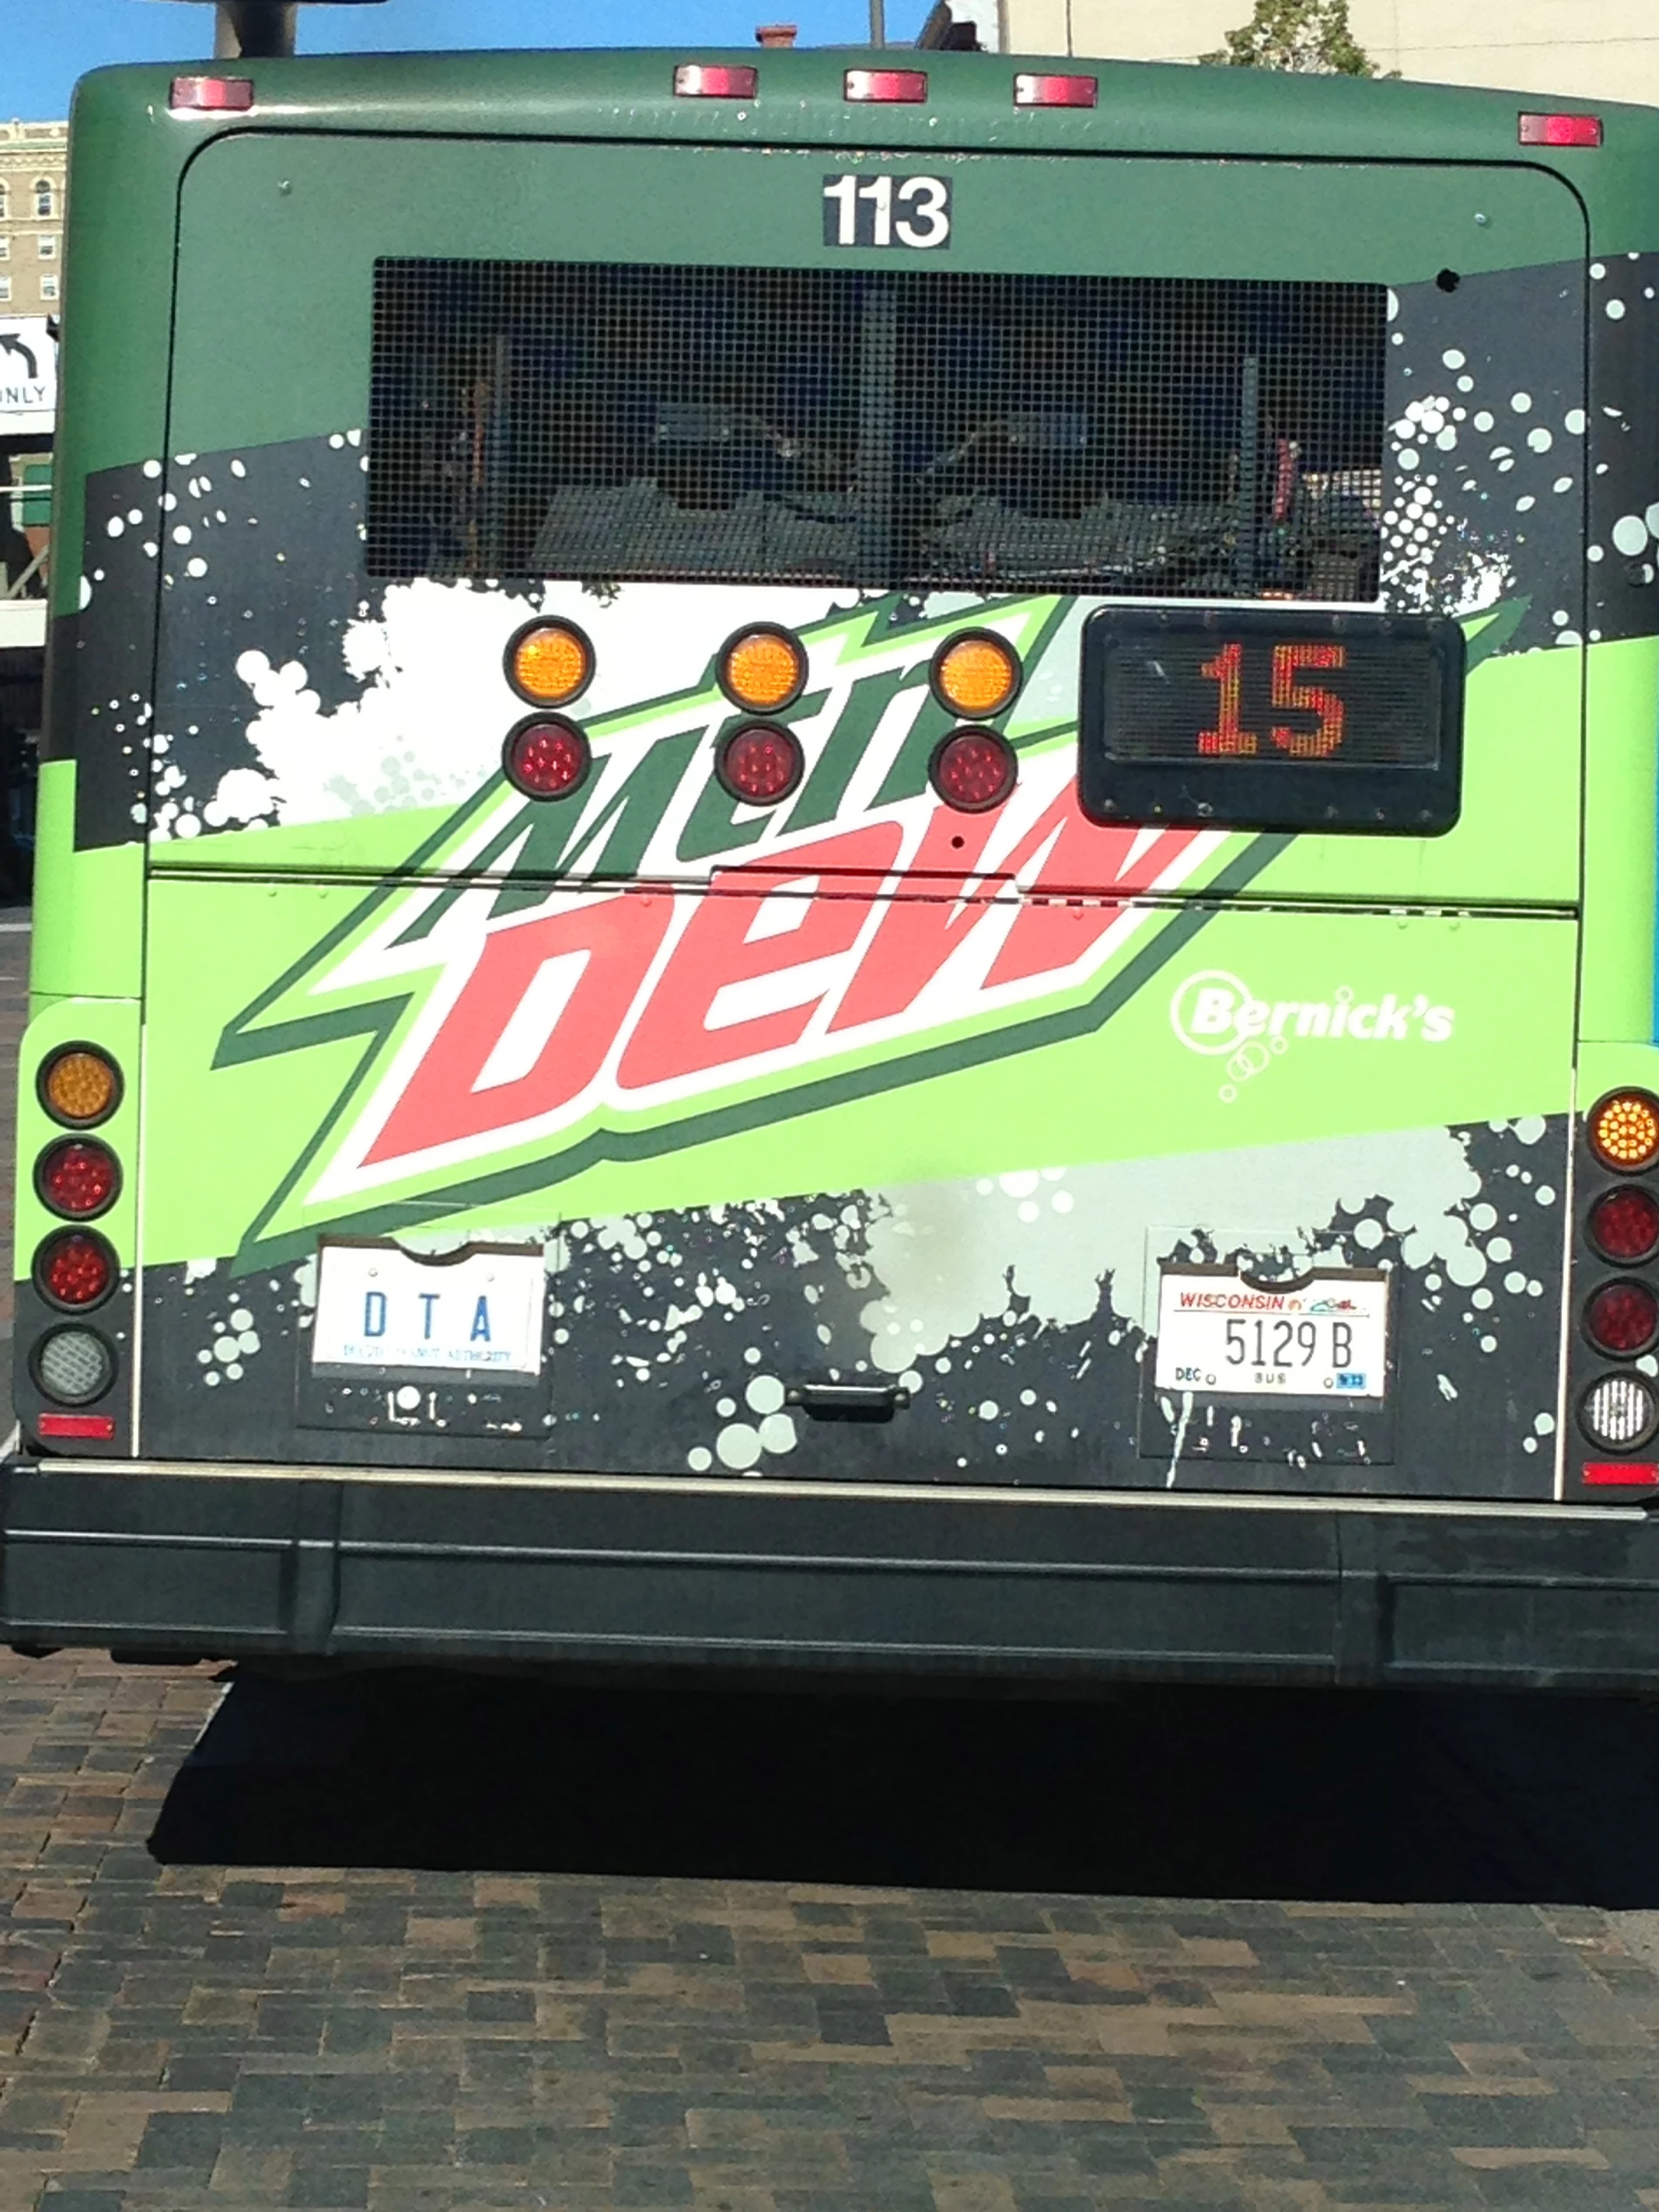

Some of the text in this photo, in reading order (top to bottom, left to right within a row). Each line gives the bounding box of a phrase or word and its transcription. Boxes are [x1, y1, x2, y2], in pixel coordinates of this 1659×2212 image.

[823, 174, 950, 248] 113
[0, 386, 46, 403] NLY
[1197, 642, 1346, 758] 15
[1191, 985, 1456, 1042] Bernick's
[1180, 1292, 1285, 1310] WISCONSIN
[1175, 1367, 1202, 1382] DEC
[1254, 1372, 1286, 1384] BUS
